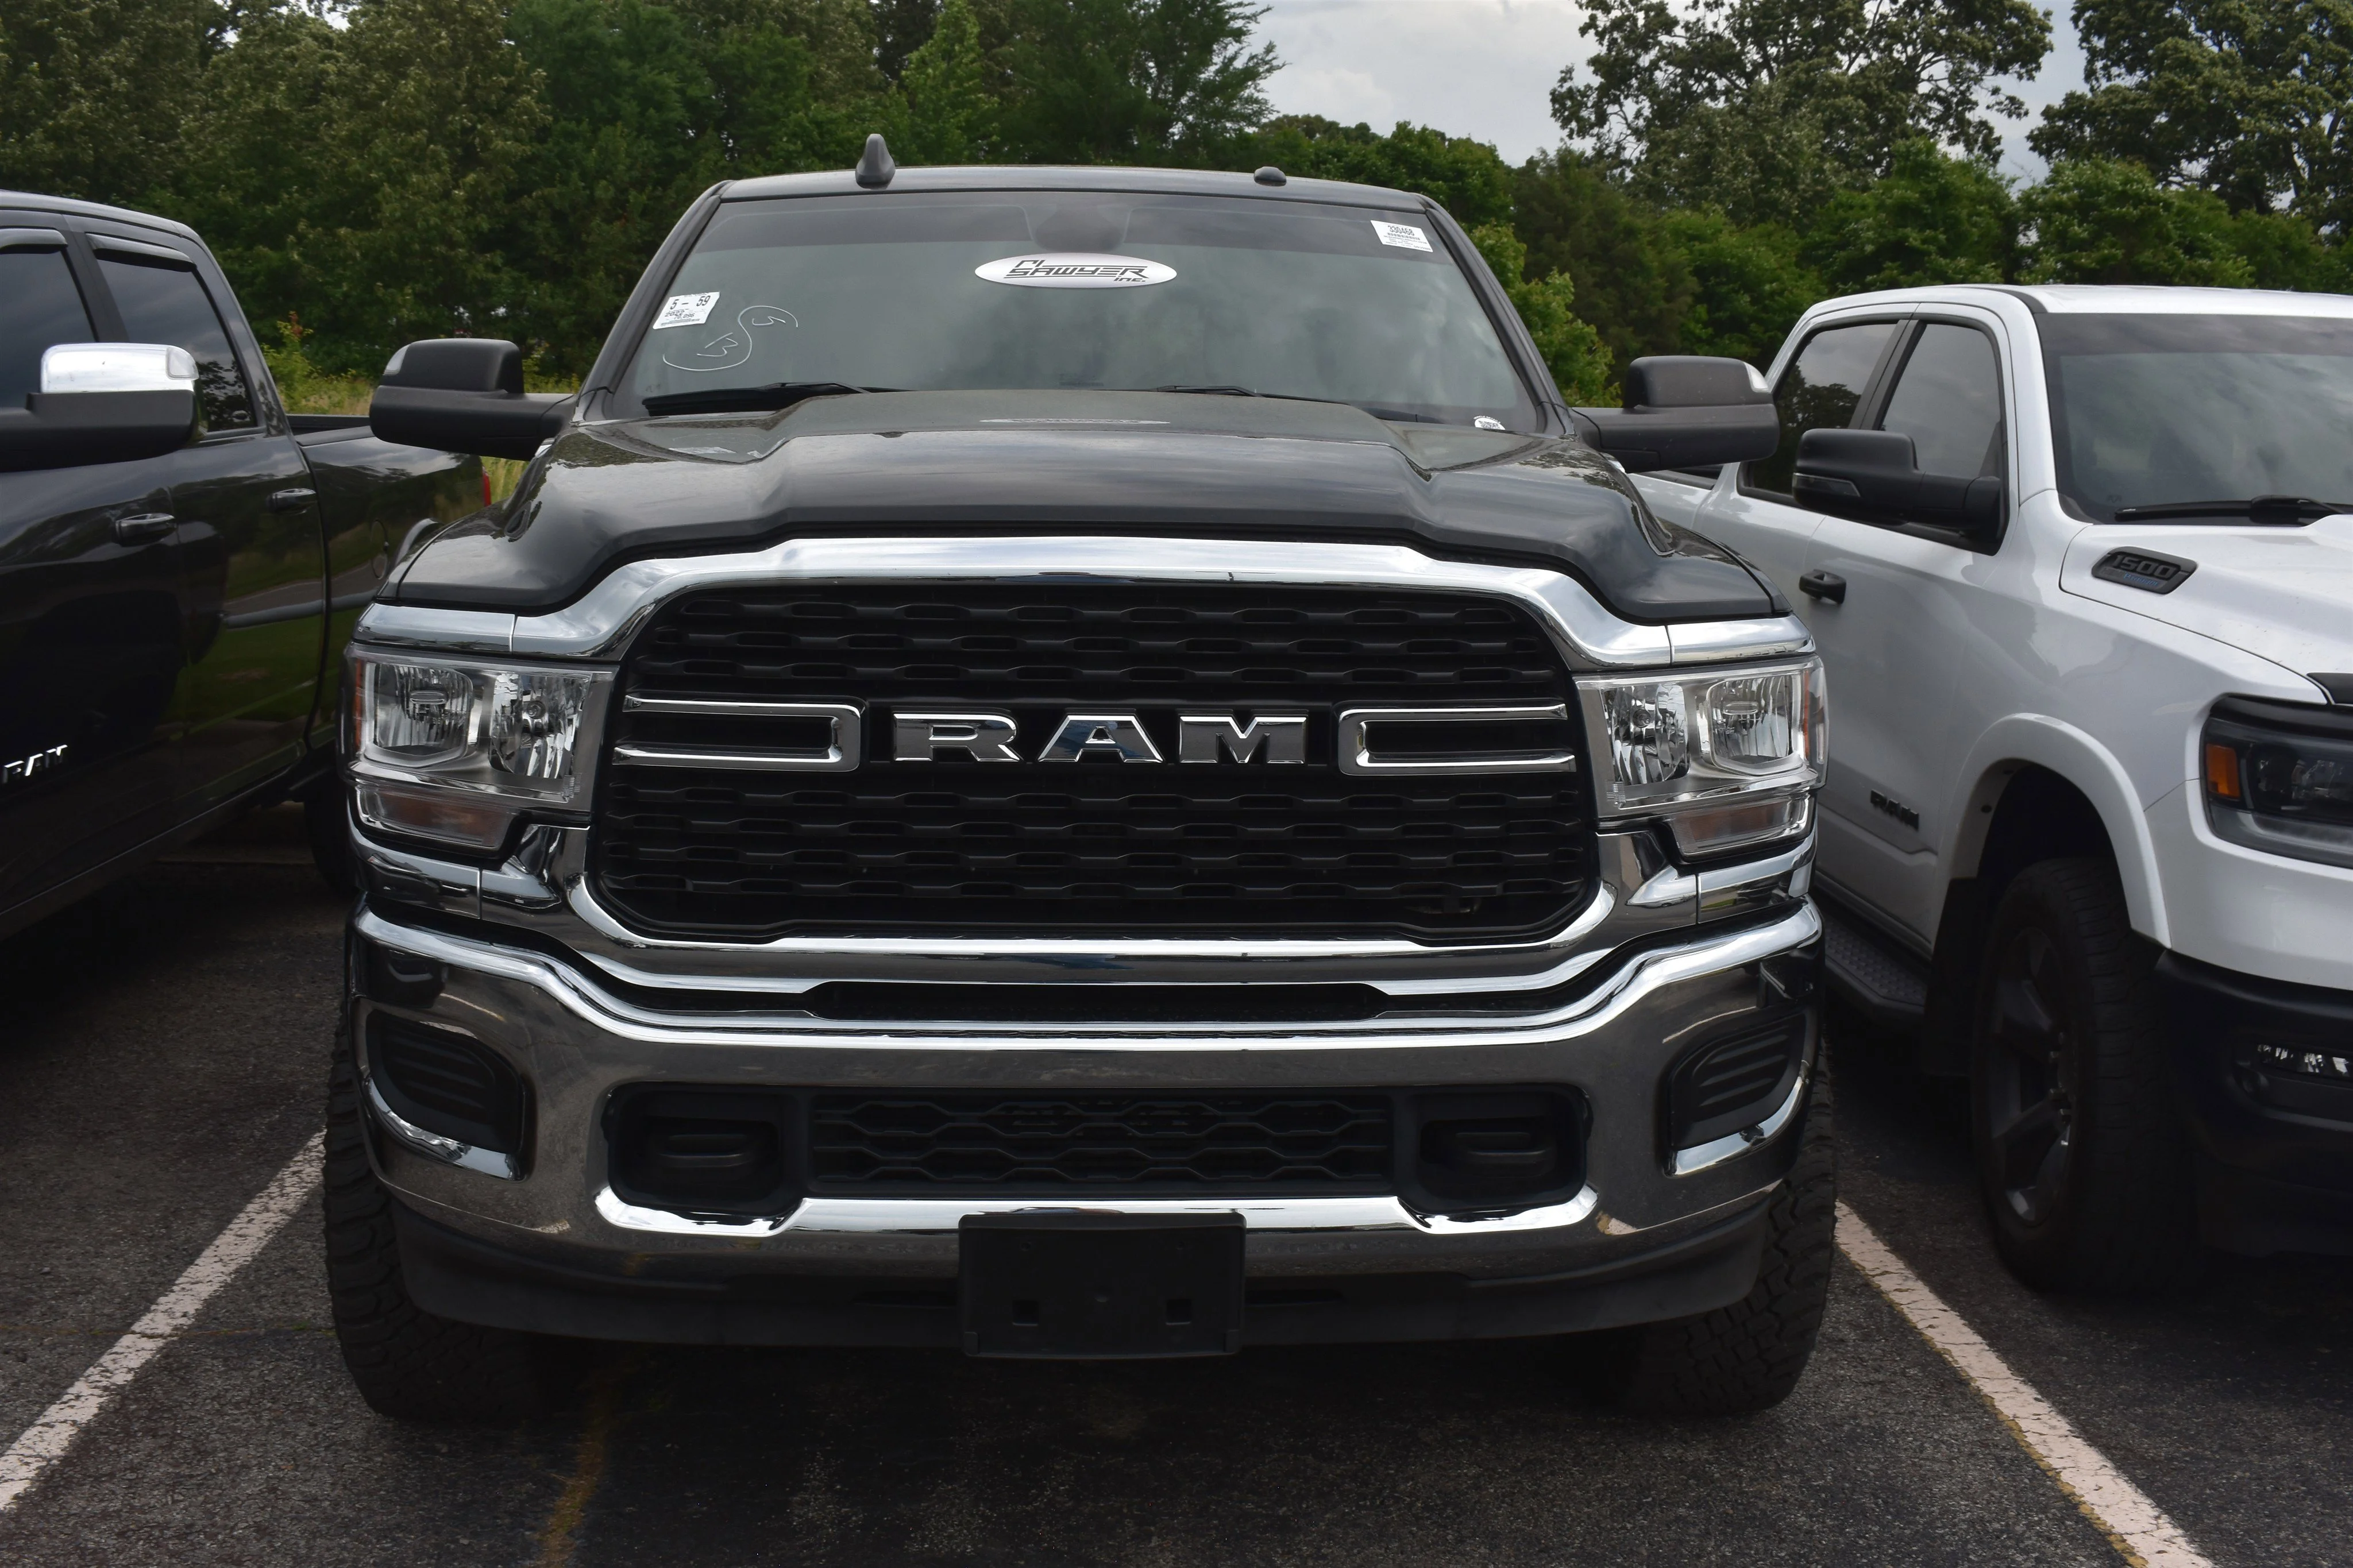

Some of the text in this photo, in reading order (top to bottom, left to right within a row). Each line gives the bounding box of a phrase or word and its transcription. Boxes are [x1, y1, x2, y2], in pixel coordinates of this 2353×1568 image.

[1006, 267, 1150, 279] SAWYER
[670, 299, 679, 310] 5
[696, 295, 711, 307] 59
[2111, 554, 2175, 578] 1500
[893, 712, 1307, 764] RAM
